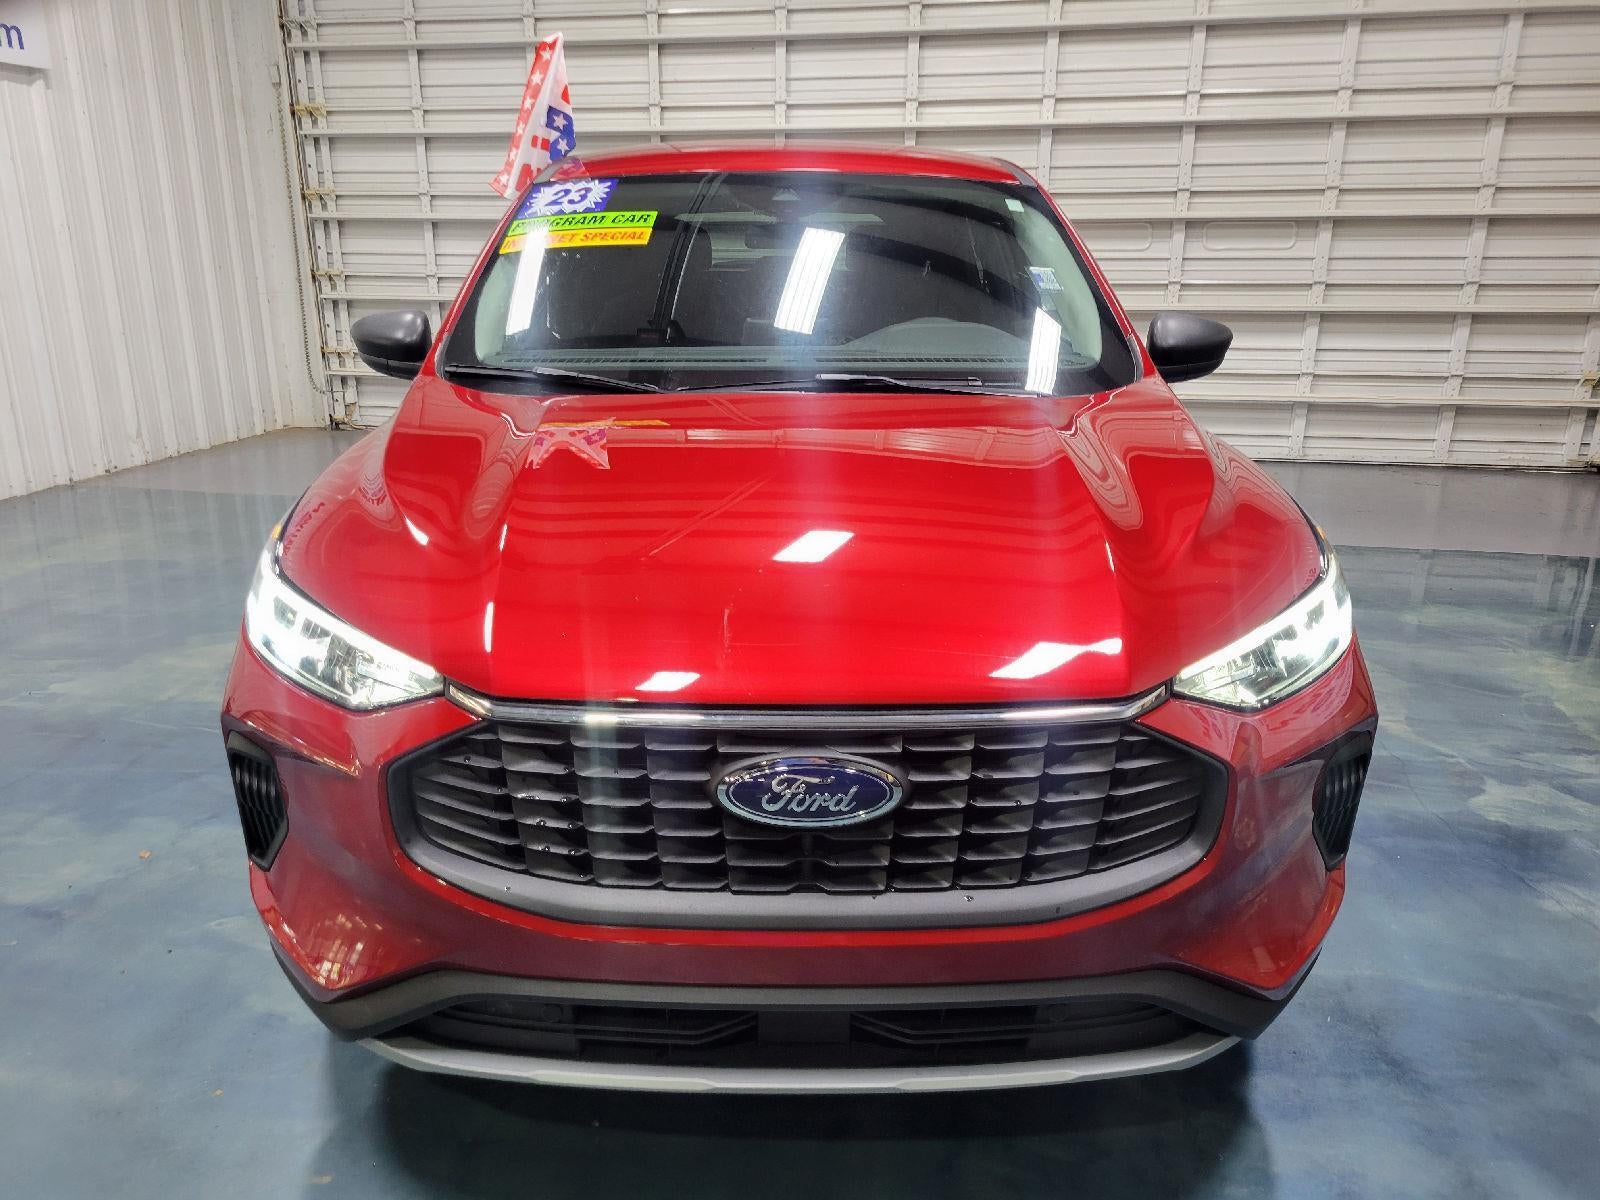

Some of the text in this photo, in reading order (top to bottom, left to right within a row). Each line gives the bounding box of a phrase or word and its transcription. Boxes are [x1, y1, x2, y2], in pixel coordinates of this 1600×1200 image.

[544, 187, 593, 207] 23
[511, 214, 651, 232] PGRAM CAR
[580, 231, 645, 242] SPECIAL
[761, 774, 860, 812] Ford
